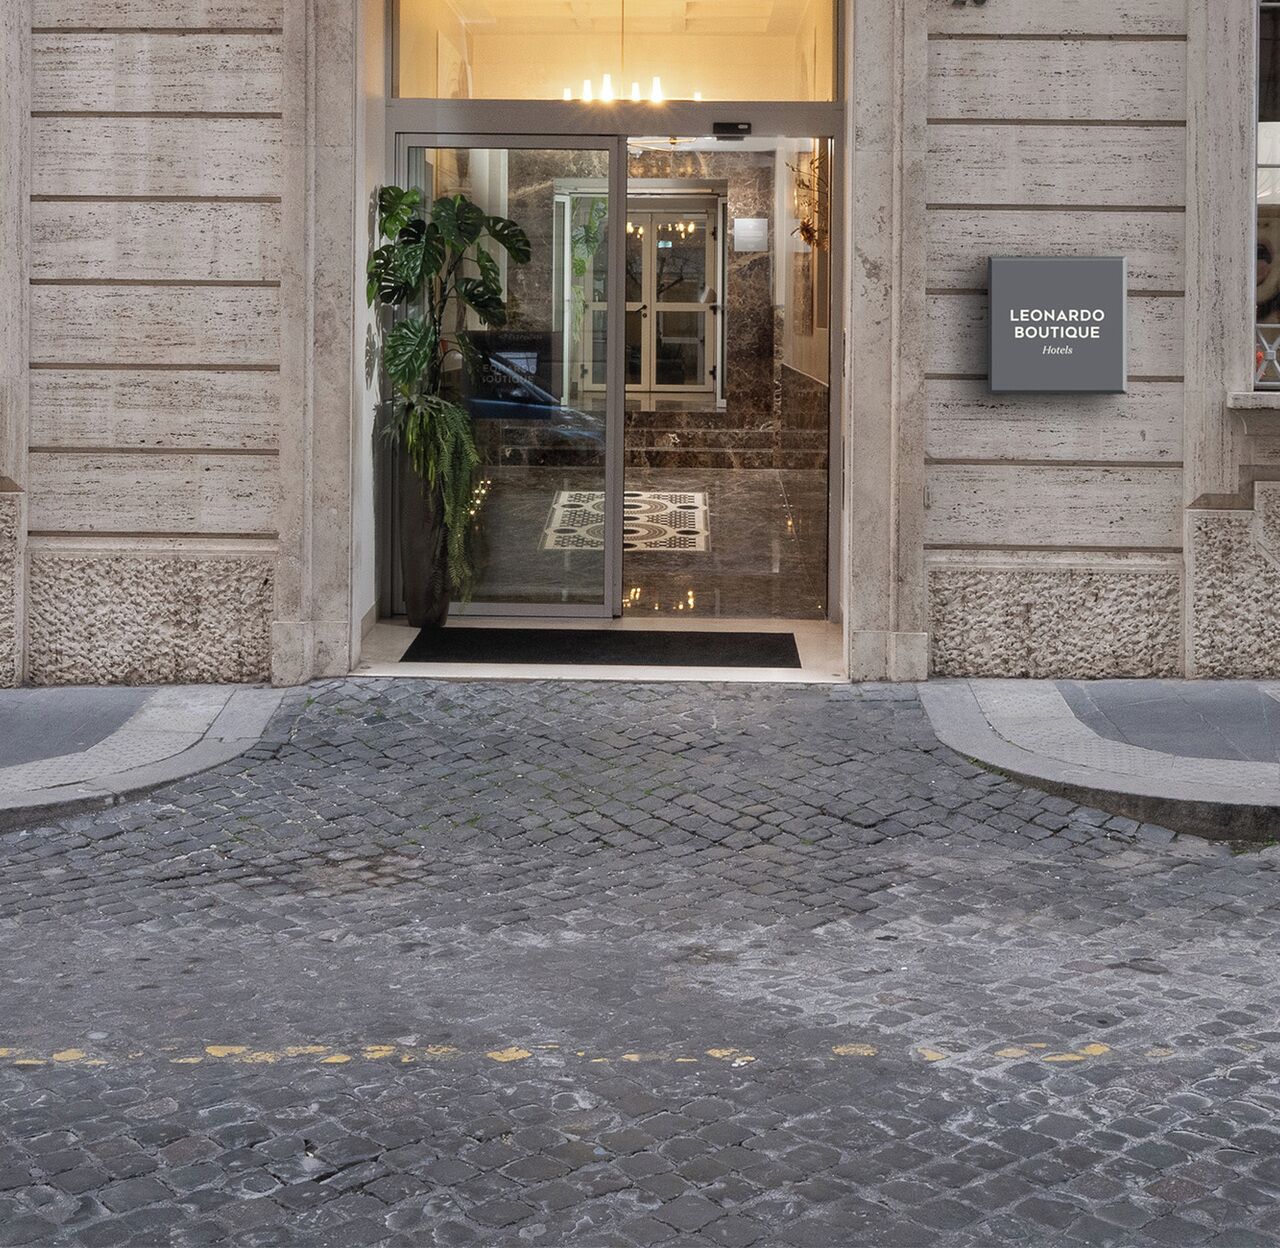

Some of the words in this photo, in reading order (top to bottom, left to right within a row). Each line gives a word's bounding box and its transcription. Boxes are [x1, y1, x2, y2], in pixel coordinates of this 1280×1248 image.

[1010, 308, 1105, 322] LEONARDO
[1014, 325, 1100, 339] BOUTIQUE
[1042, 344, 1073, 355] Hotels
